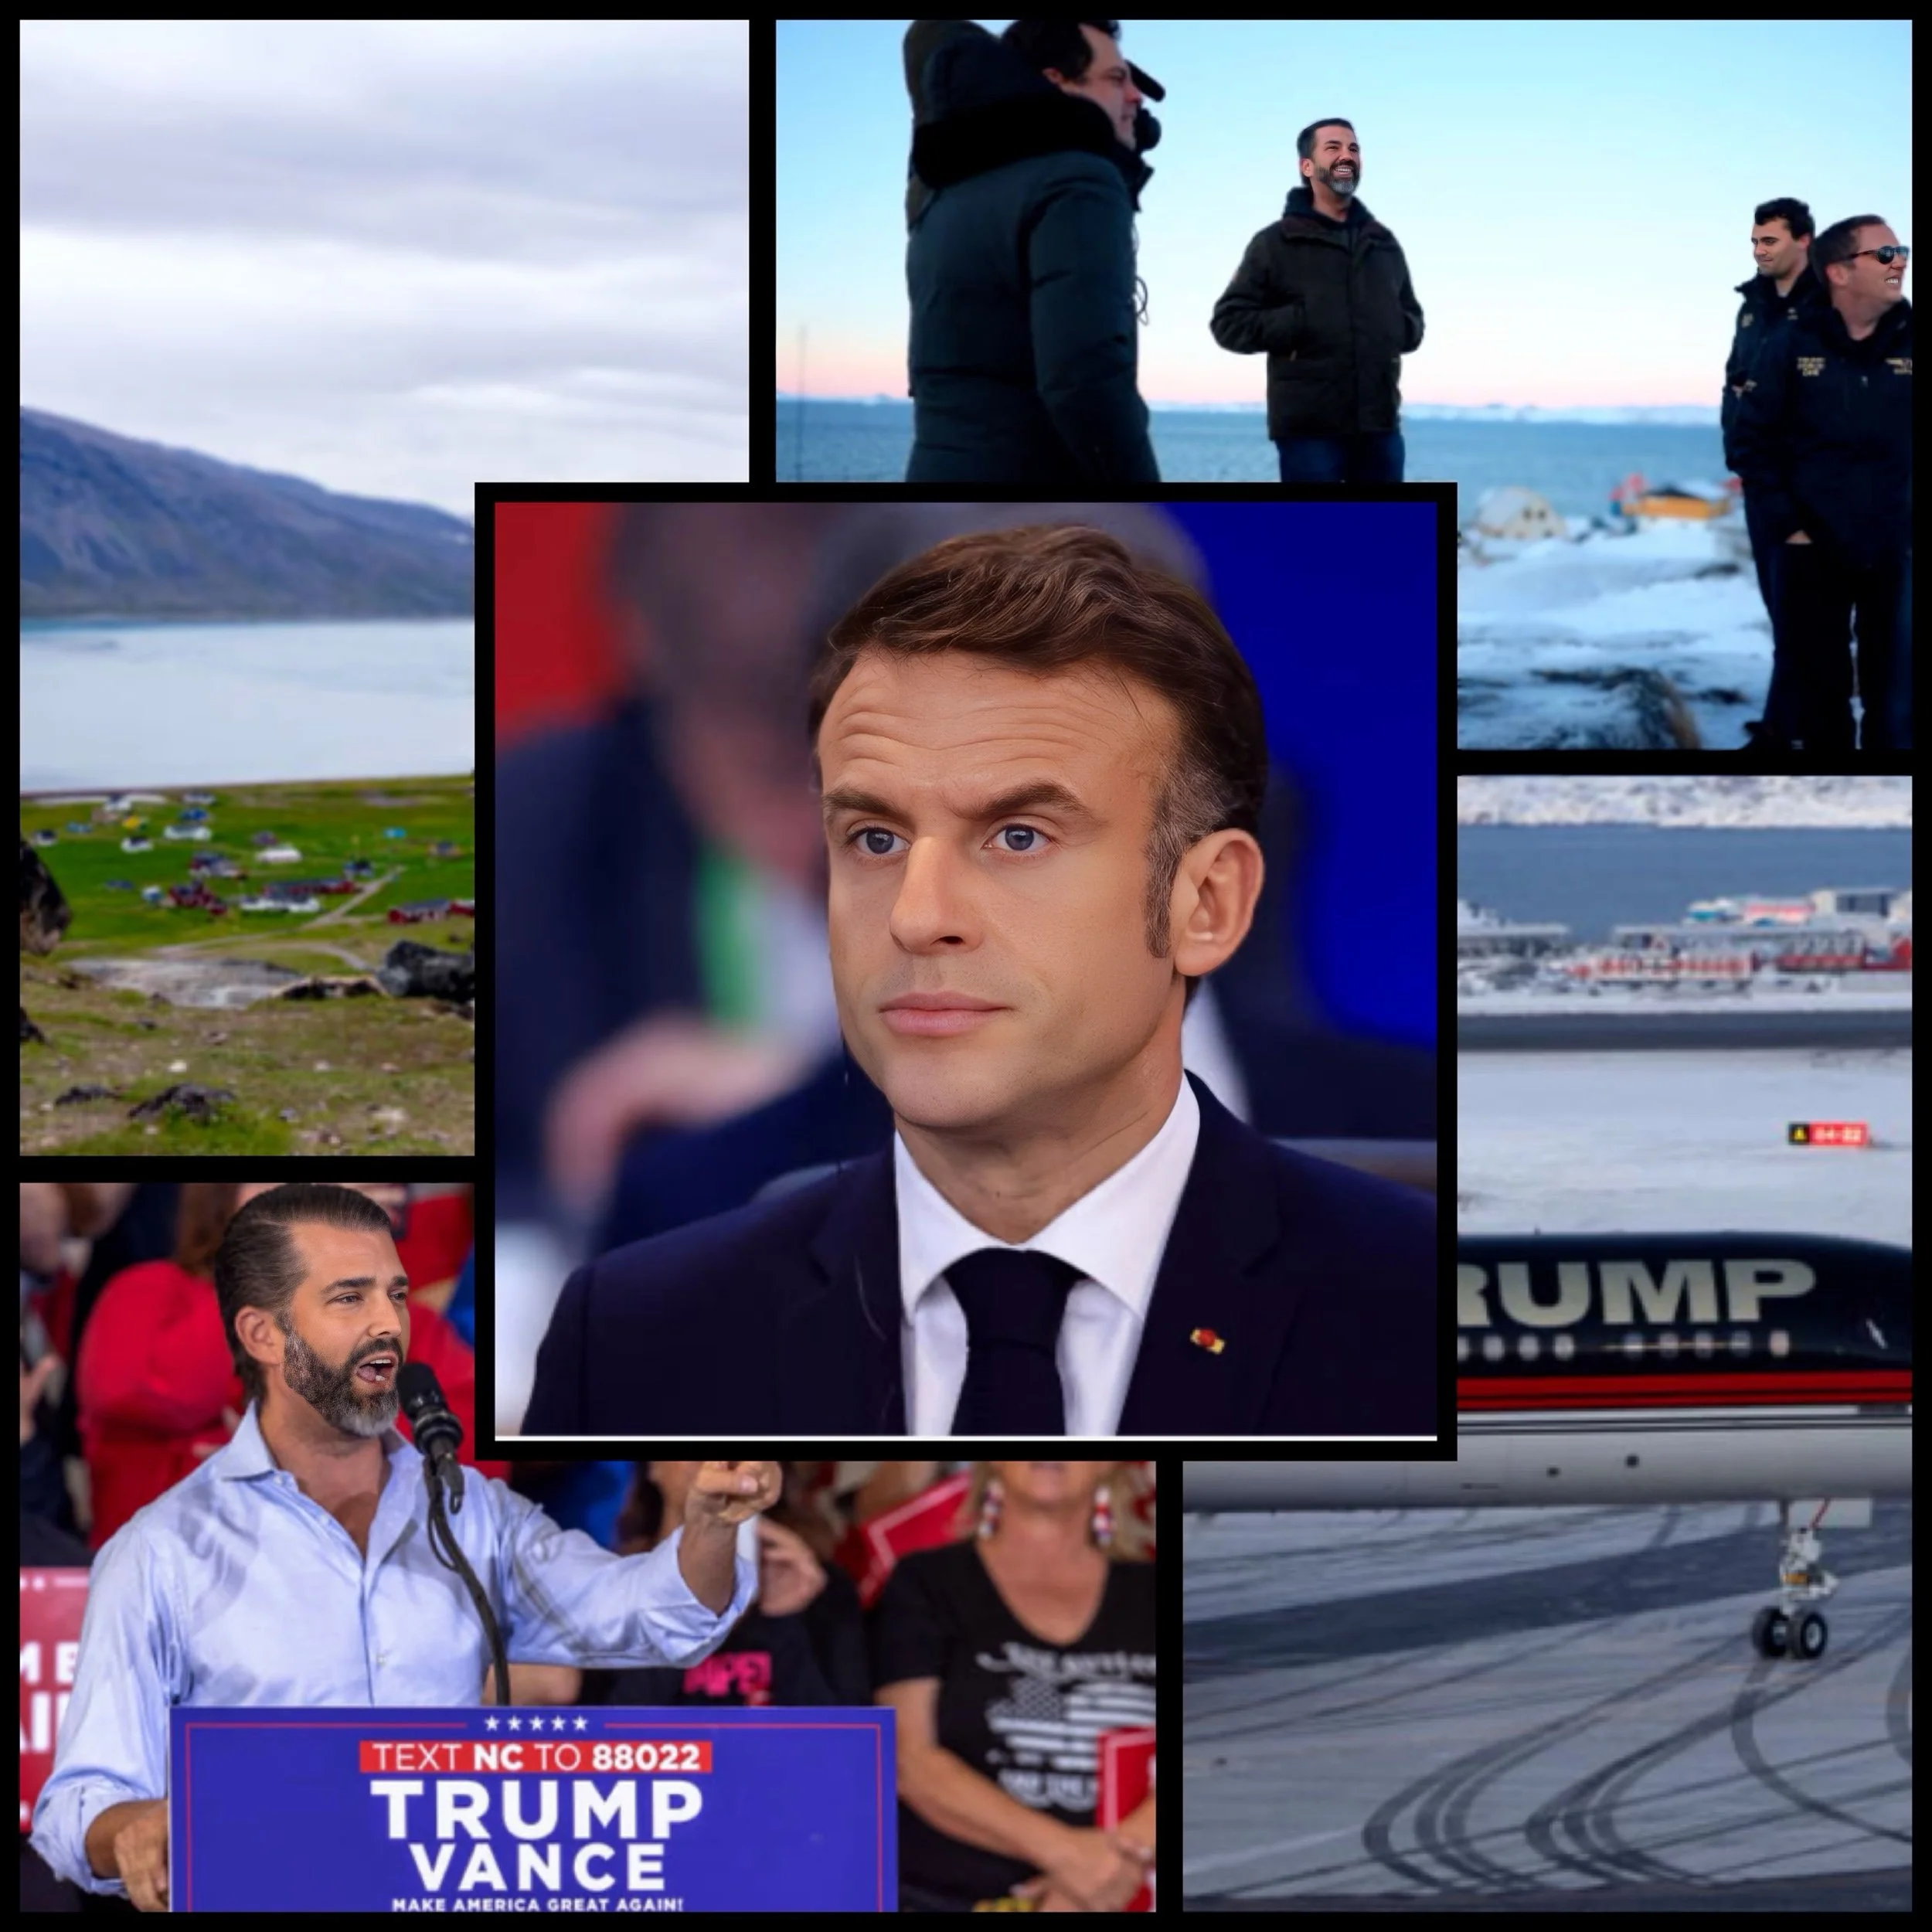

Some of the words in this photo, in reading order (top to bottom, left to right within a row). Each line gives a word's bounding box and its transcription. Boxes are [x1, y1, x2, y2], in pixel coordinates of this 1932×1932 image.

[372, 1743, 461, 1770] TEXT
[474, 1743, 523, 1770] NC
[534, 1743, 580, 1770] TO
[592, 1743, 700, 1770] 88022
[370, 1780, 702, 1840] TRUMP
[409, 1843, 665, 1892] VANCE
[392, 1898, 445, 1912] MAKE
[453, 1898, 539, 1912] AMERICA
[547, 1898, 609, 1912] GREAT
[616, 1898, 683, 1912] AGAIN!
